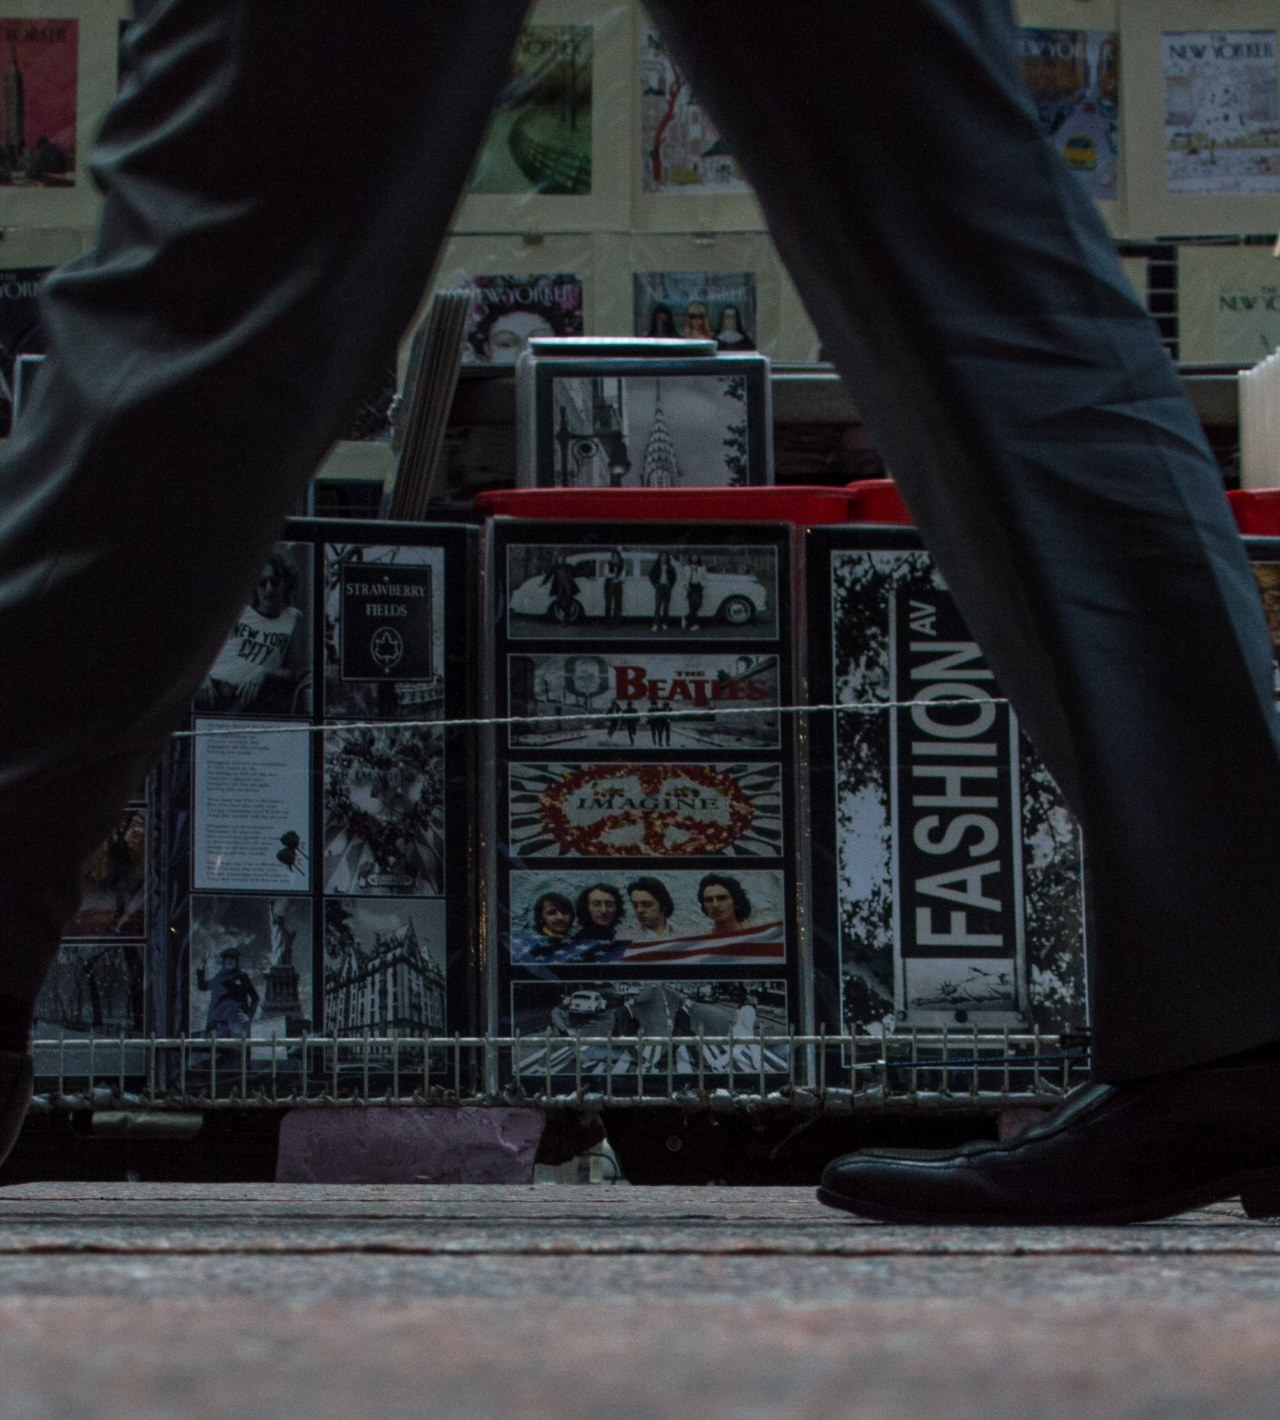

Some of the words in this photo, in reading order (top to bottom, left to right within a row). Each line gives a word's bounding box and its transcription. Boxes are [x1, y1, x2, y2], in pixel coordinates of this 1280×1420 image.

[1169, 45, 1206, 59] NEW
[1209, 43, 1274, 59] YORKER
[1220, 294, 1260, 311] NEW
[345, 582, 426, 597] STRAWBERRY
[365, 604, 408, 617] FIELDS
[909, 600, 936, 636] AV
[238, 639, 275, 665] CITY
[613, 666, 768, 707] BEATLES
[909, 641, 1003, 946] FASHION
[576, 798, 719, 810] IMAGINE
